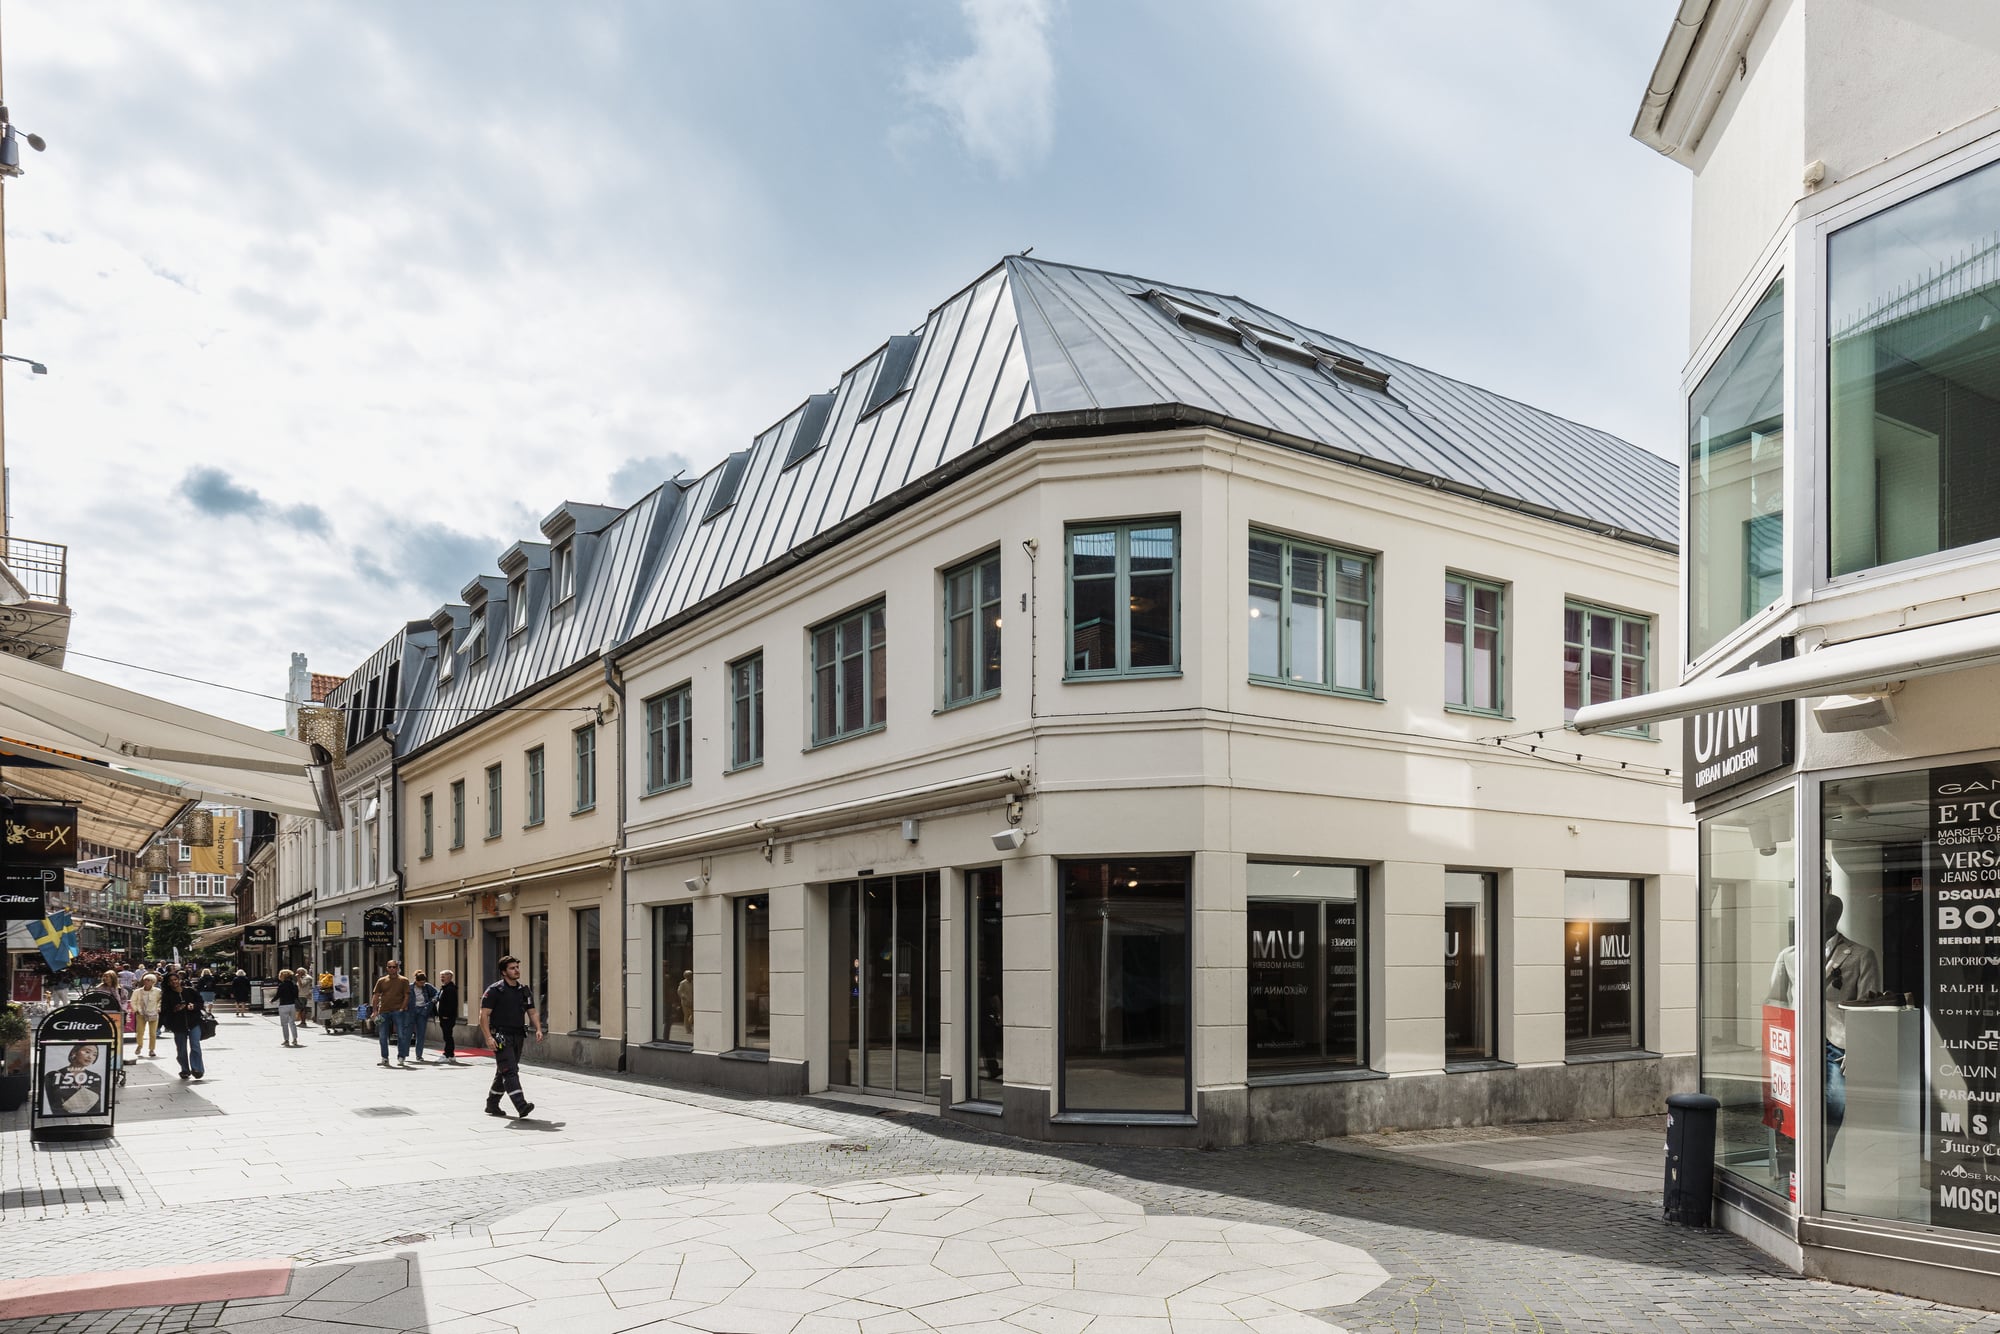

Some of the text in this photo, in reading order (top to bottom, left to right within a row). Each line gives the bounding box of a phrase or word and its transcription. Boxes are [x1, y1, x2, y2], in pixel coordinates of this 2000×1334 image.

[1695, 746, 1758, 788] URBAN MODERN
[1938, 826, 1993, 838] MARCELO
[217, 820, 226, 870] AQUADENTAL
[1938, 834, 1985, 846] COUNTY
[1940, 870, 1977, 883] JEANS
[1938, 904, 2000, 930] BO
[430, 921, 462, 937] MQ
[1938, 936, 1981, 945] HERON
[1939, 956, 1988, 966] EMPORIO
[1940, 983, 1984, 993] RALPH
[1939, 1008, 1981, 1016] TOMMY
[53, 1020, 102, 1031] Glitter
[1772, 1031, 1789, 1053] REA
[1939, 1064, 1997, 1079] CALVIN
[1772, 1072, 1789, 1099] 50%
[1940, 1138, 1980, 1157] Juicy
[1940, 1164, 1982, 1180] MOOSE
[1940, 1184, 2000, 1214] MOSC
